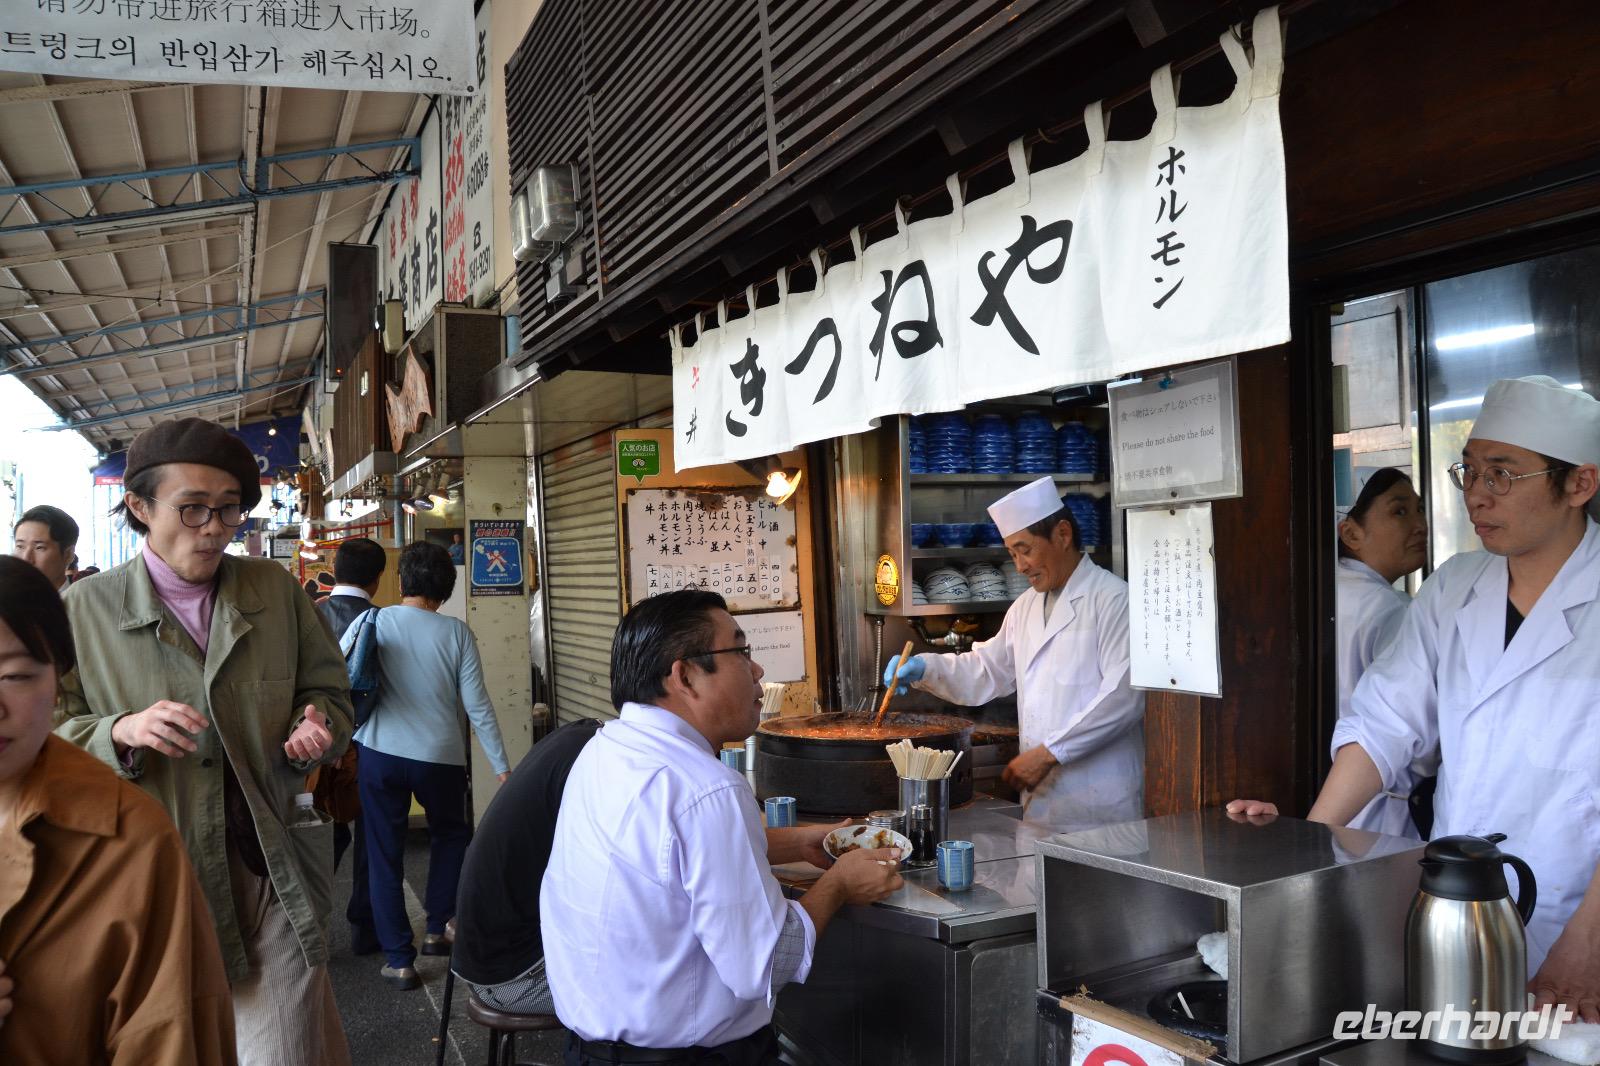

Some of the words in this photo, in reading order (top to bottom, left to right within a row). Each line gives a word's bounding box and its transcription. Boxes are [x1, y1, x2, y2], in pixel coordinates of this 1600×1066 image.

[1, 32, 136, 65] 트렁크의
[160, 38, 284, 73] 반입삼가
[301, 50, 452, 82] 해주십시오.
[1150, 146, 1189, 309] ホルモン
[726, 215, 1074, 438] きつねや
[622, 443, 656, 452] 人気のお店
[1122, 440, 1144, 451] Please
[1145, 437, 1154, 447] do
[1155, 436, 1166, 446] not
[1167, 432, 1186, 444] share
[1187, 429, 1200, 440] the
[1200, 425, 1215, 437] food
[658, 501, 670, 557] ホルモン丼
[671, 501, 683, 555] ホルモン煮
[683, 500, 695, 546] 肉どうふ
[694, 501, 707, 546] 焼どうふ
[721, 500, 731, 531] ごはん
[733, 500, 743, 543] おしんこ
[746, 502, 756, 537] 生玉子
[758, 500, 767, 529] ビール
[710, 541, 720, 553] 並
[722, 540, 732, 551] 大
[759, 539, 767, 550] 中
[663, 573, 671, 589] 八五
[675, 570, 683, 587] 六五
[698, 566, 709, 587] 二五
